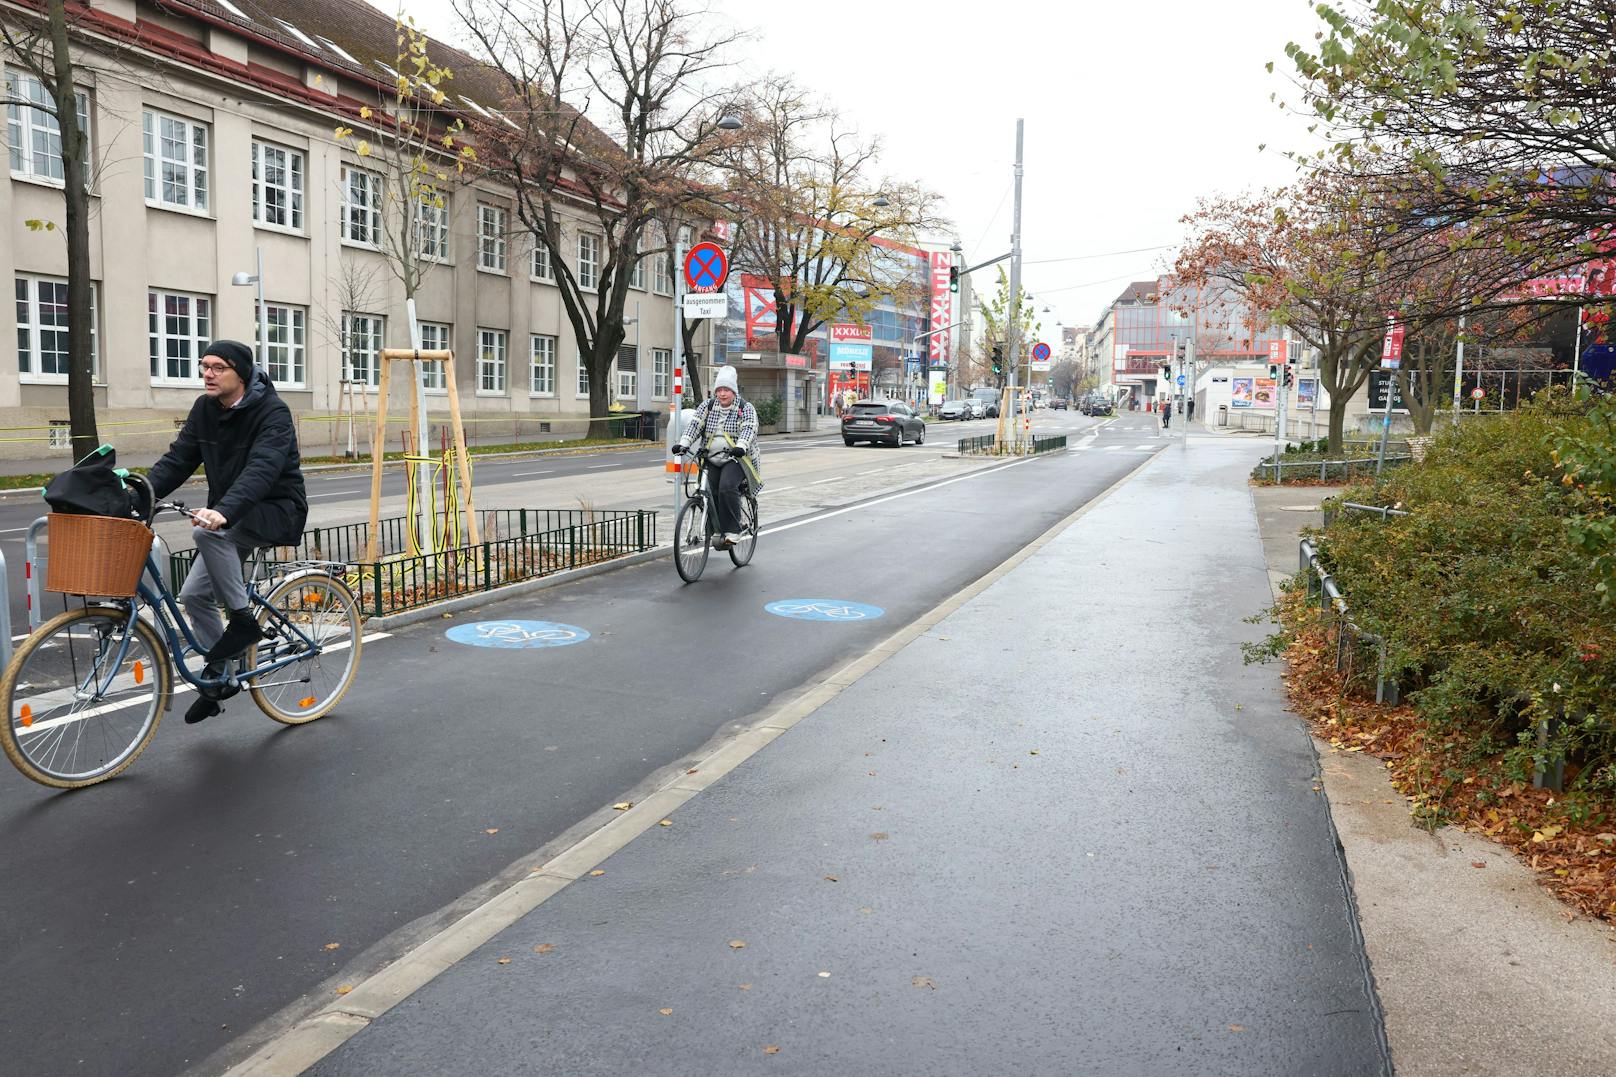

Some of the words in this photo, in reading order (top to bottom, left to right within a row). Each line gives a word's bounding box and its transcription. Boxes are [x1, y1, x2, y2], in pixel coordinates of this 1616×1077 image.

[694, 283, 718, 292] ANFANG
[686, 298, 725, 306] ausgenommen
[932, 253, 950, 356] XXXLutz
